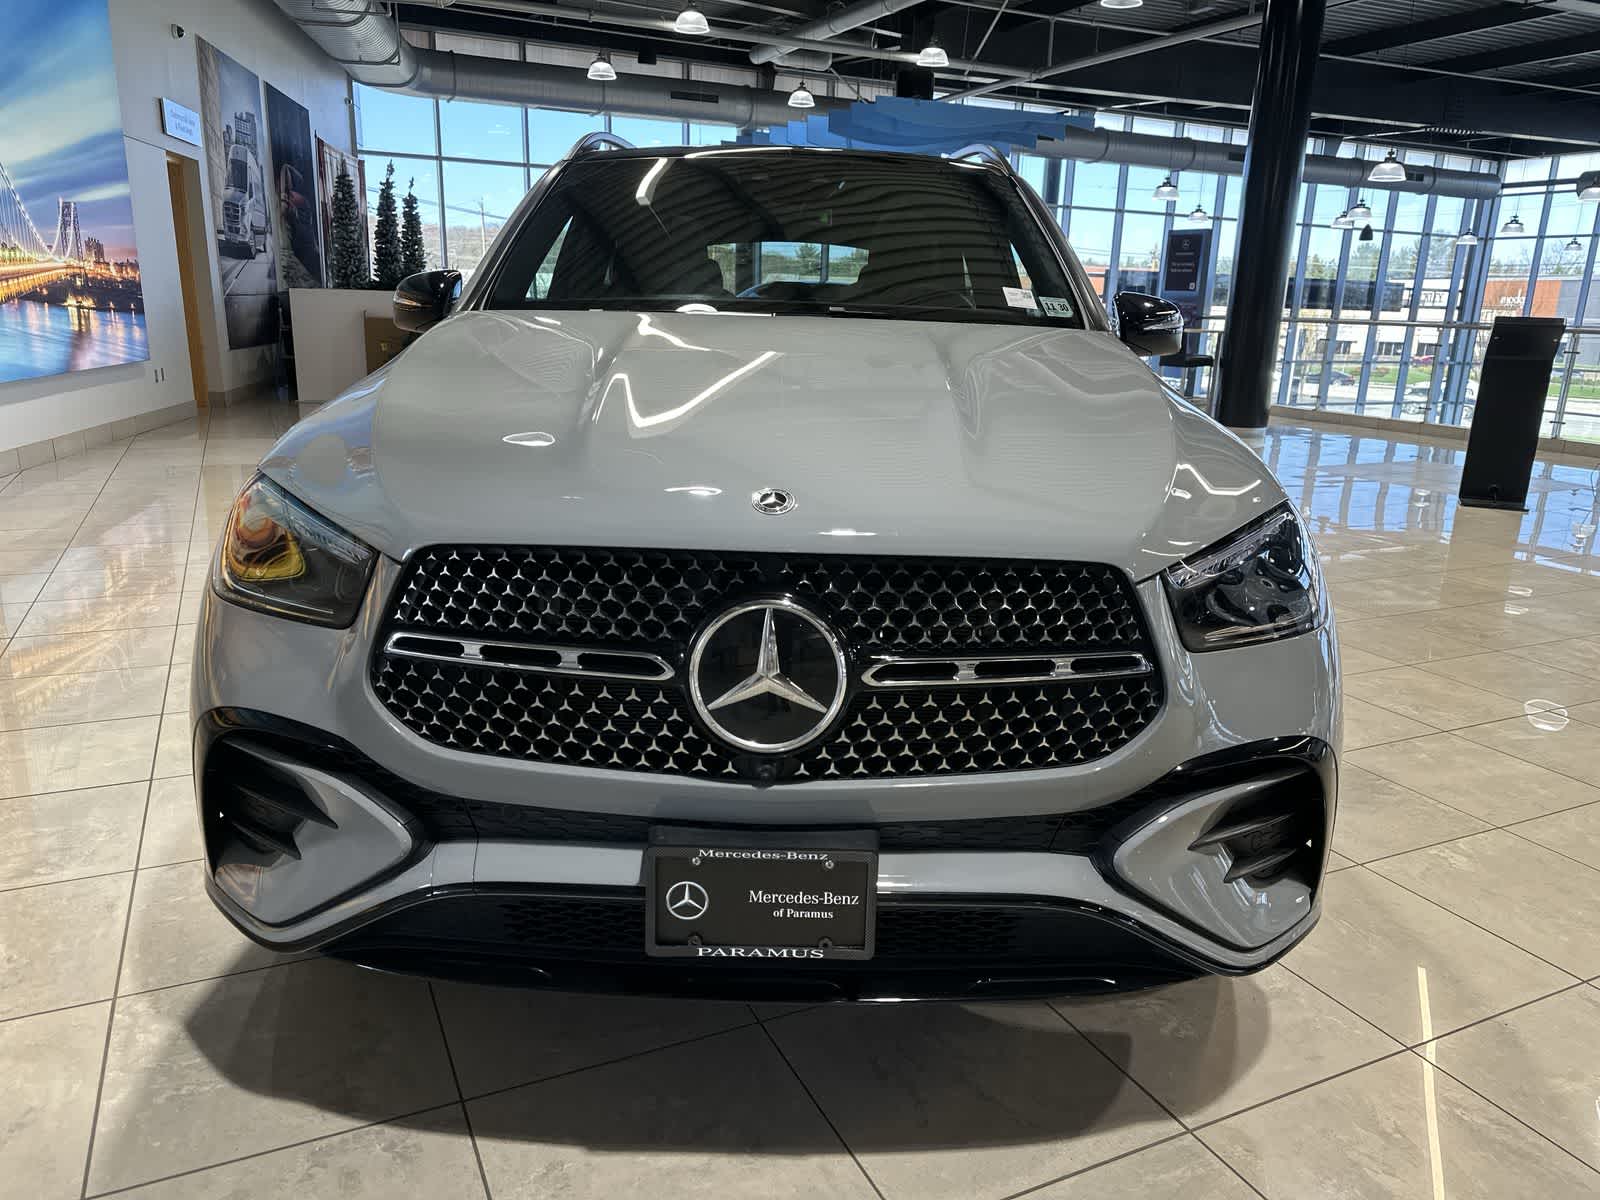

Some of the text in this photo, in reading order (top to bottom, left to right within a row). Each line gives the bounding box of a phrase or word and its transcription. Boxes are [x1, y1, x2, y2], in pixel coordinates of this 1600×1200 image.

[698, 848, 829, 861] Mercedes-Benz
[749, 890, 860, 905] Mercedes-Benz
[773, 909, 834, 919] of Paramus
[696, 947, 825, 959] PARAMUS
